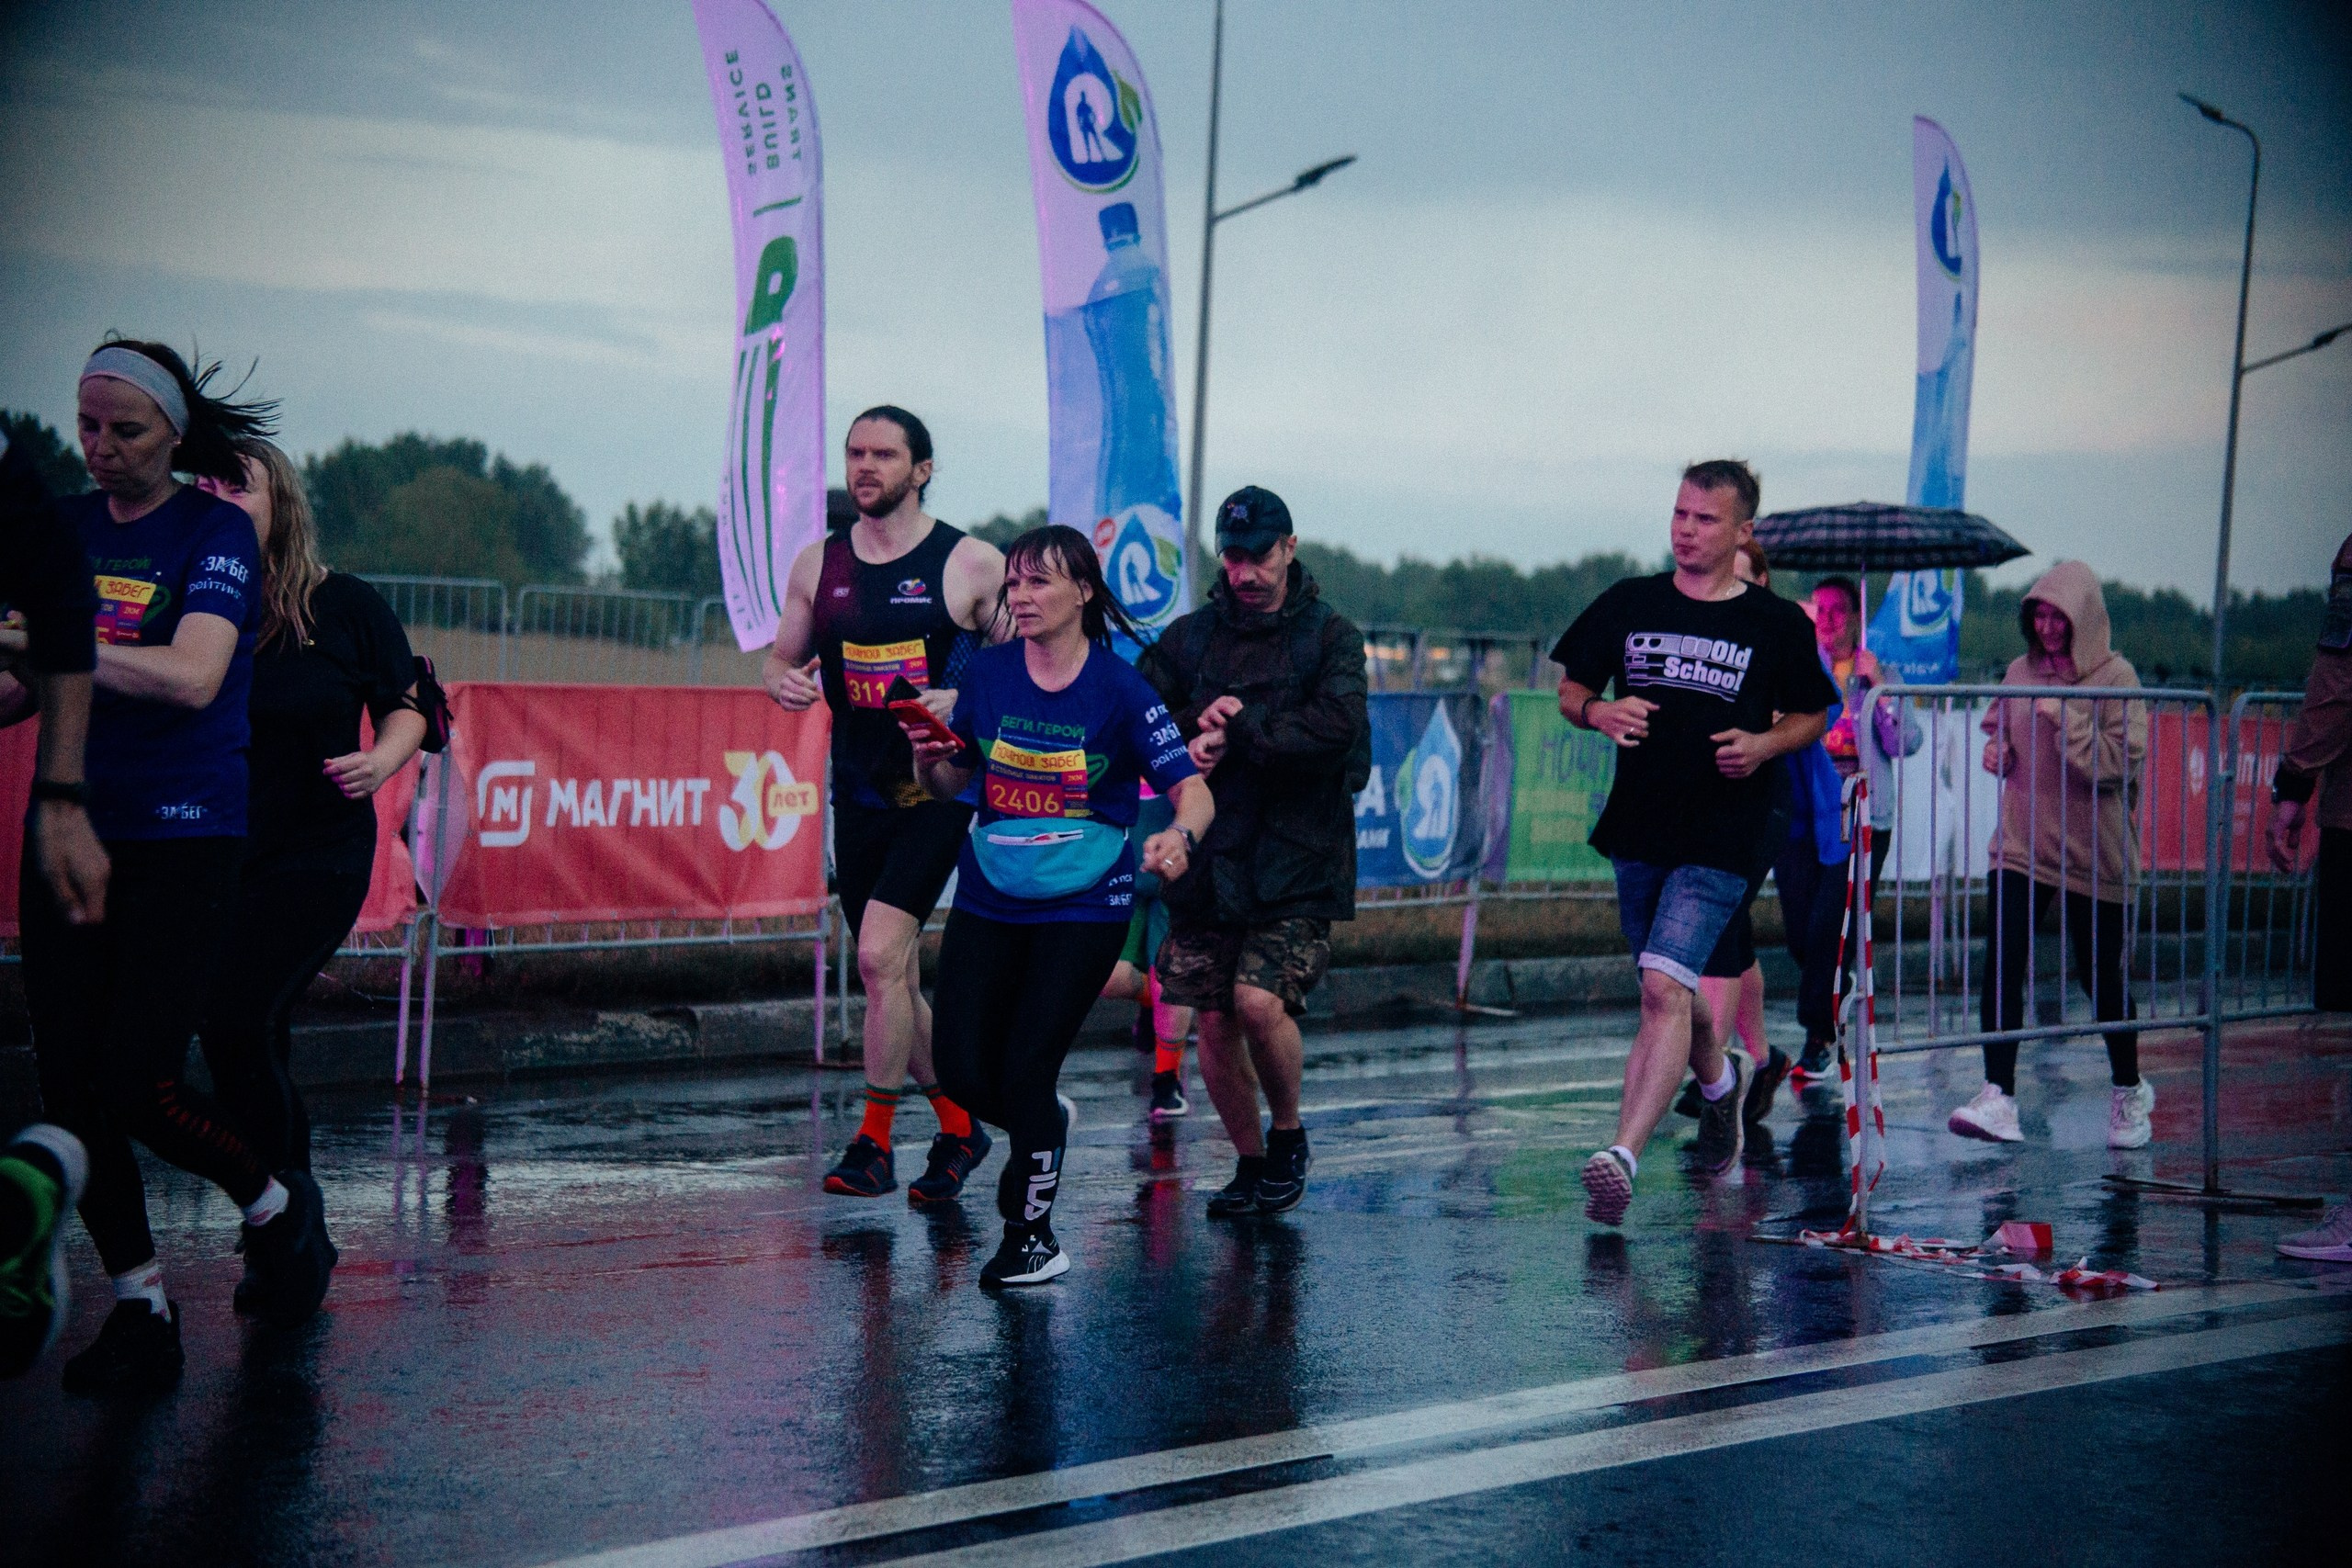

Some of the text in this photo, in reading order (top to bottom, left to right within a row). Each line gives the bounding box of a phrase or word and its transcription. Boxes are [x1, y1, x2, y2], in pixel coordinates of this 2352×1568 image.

[105, 580, 152, 599] ЗАБЕГ
[1709, 639, 1753, 671] Old
[1663, 655, 1746, 693] School
[847, 677, 887, 704] 311
[1040, 750, 1081, 769] ЗАБЕГ
[546, 777, 711, 828] МАГНИТ
[718, 750, 809, 852] 30 лет
[991, 784, 1060, 814] 2406
[1023, 1147, 1062, 1222] FILA
